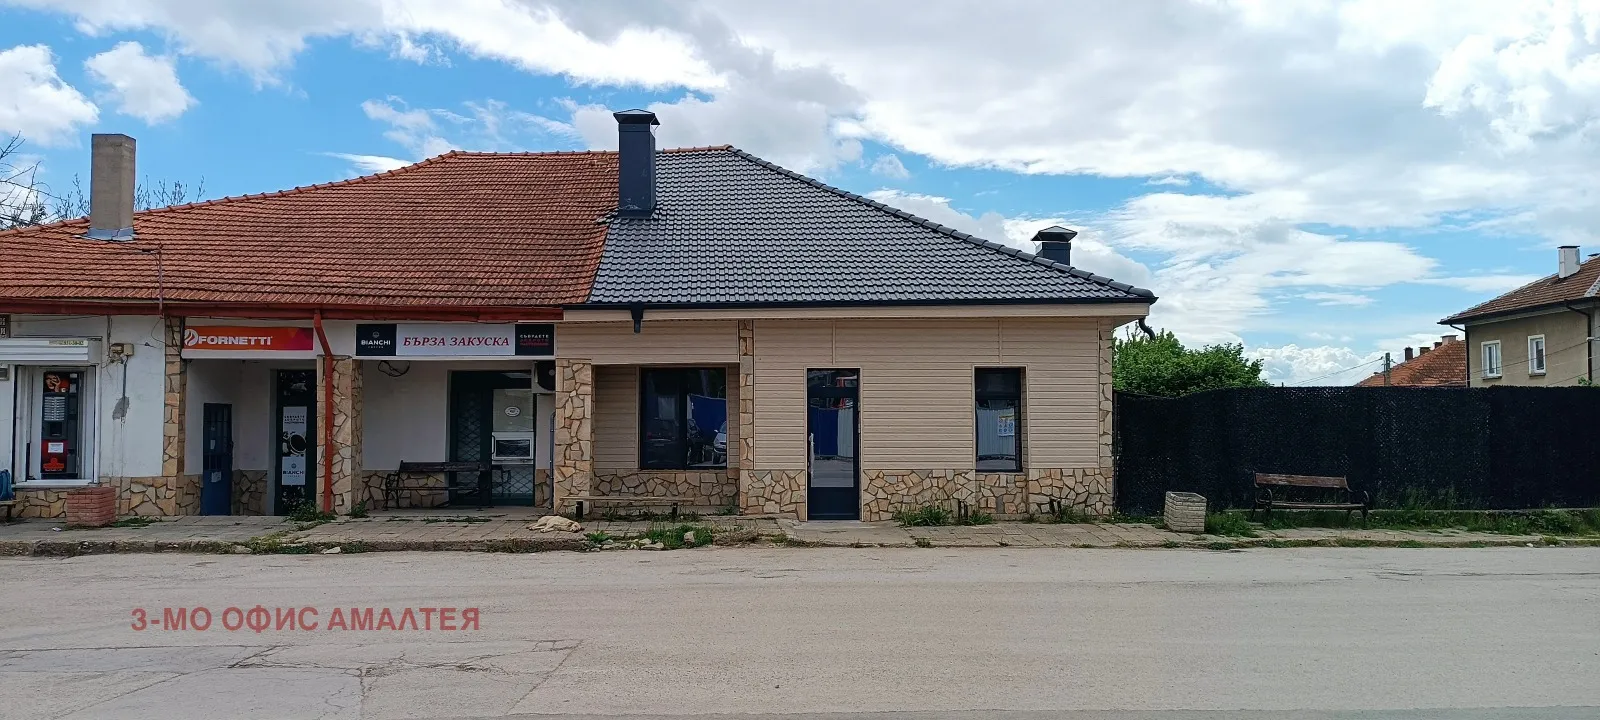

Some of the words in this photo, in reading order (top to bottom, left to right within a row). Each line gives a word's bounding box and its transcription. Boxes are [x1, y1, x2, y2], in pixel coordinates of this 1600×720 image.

[198, 336, 271, 345] FORNETTI
[403, 337, 446, 346] БЪРЗА
[449, 337, 510, 346] ЗАКУСКА
